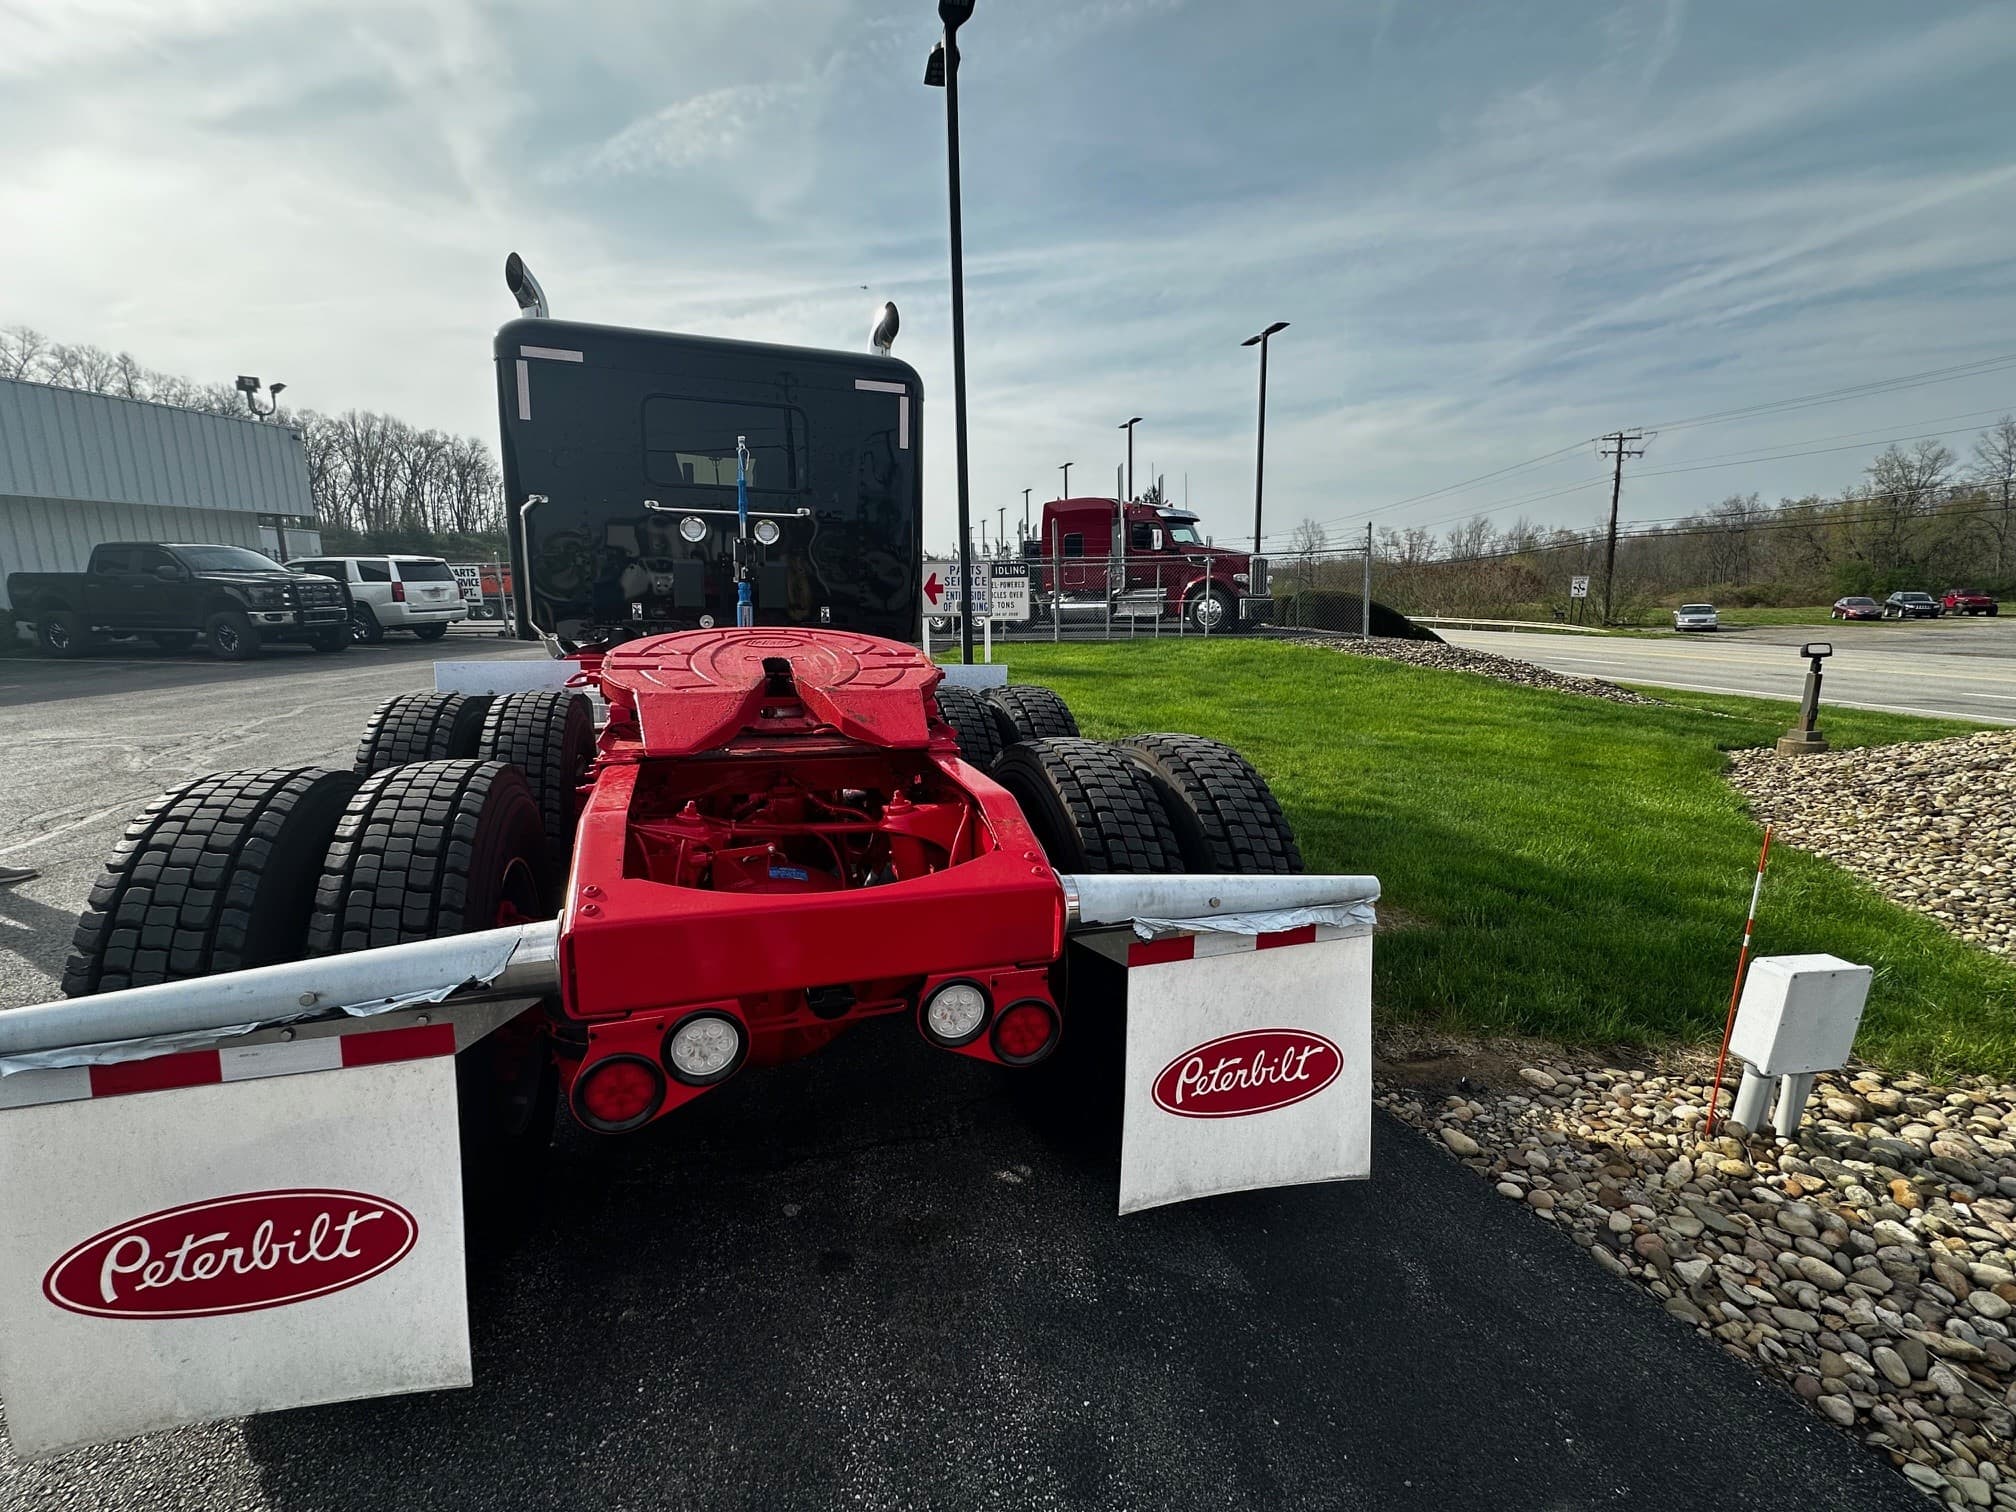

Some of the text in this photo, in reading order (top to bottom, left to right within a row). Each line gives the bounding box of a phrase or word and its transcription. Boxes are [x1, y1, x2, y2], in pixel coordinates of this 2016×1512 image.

[950, 565, 981, 575] PATS
[995, 565, 1025, 575] IDLING
[463, 588, 477, 597] PT.
[943, 602, 953, 612] OF
[997, 601, 1015, 609] TONS
[1175, 1045, 1325, 1104] Peterbilt
[99, 1210, 384, 1304] Peterbilt
